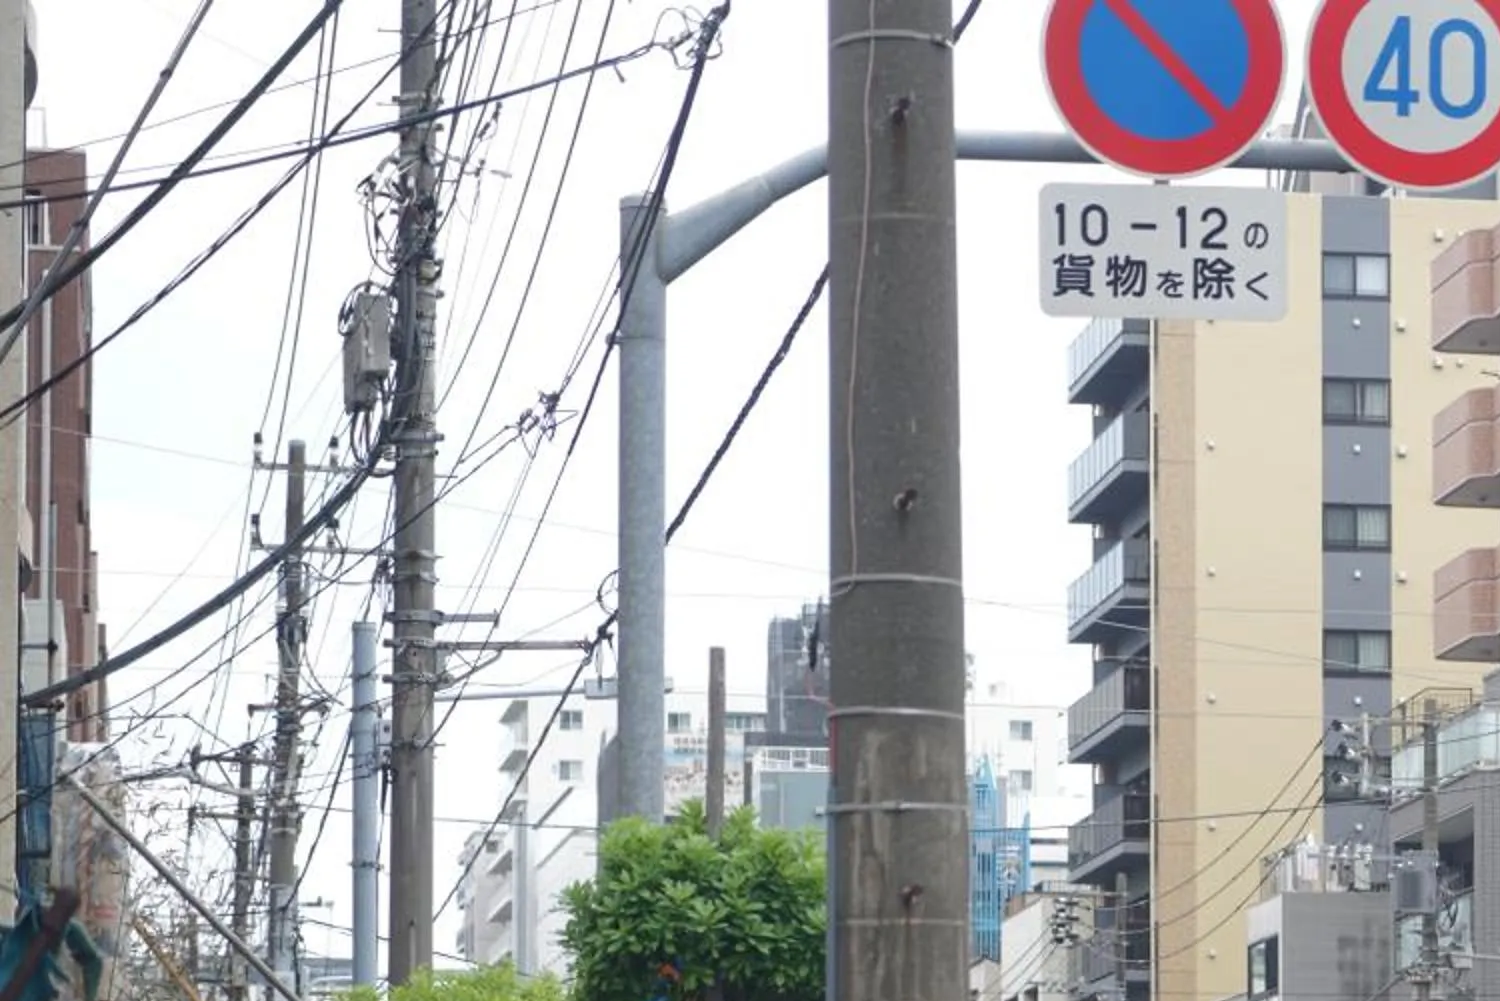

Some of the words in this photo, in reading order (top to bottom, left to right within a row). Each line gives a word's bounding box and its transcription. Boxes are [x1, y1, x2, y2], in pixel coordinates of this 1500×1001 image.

[1363, 15, 1487, 119] 40
[1052, 254, 1269, 300] 貨物を除く
